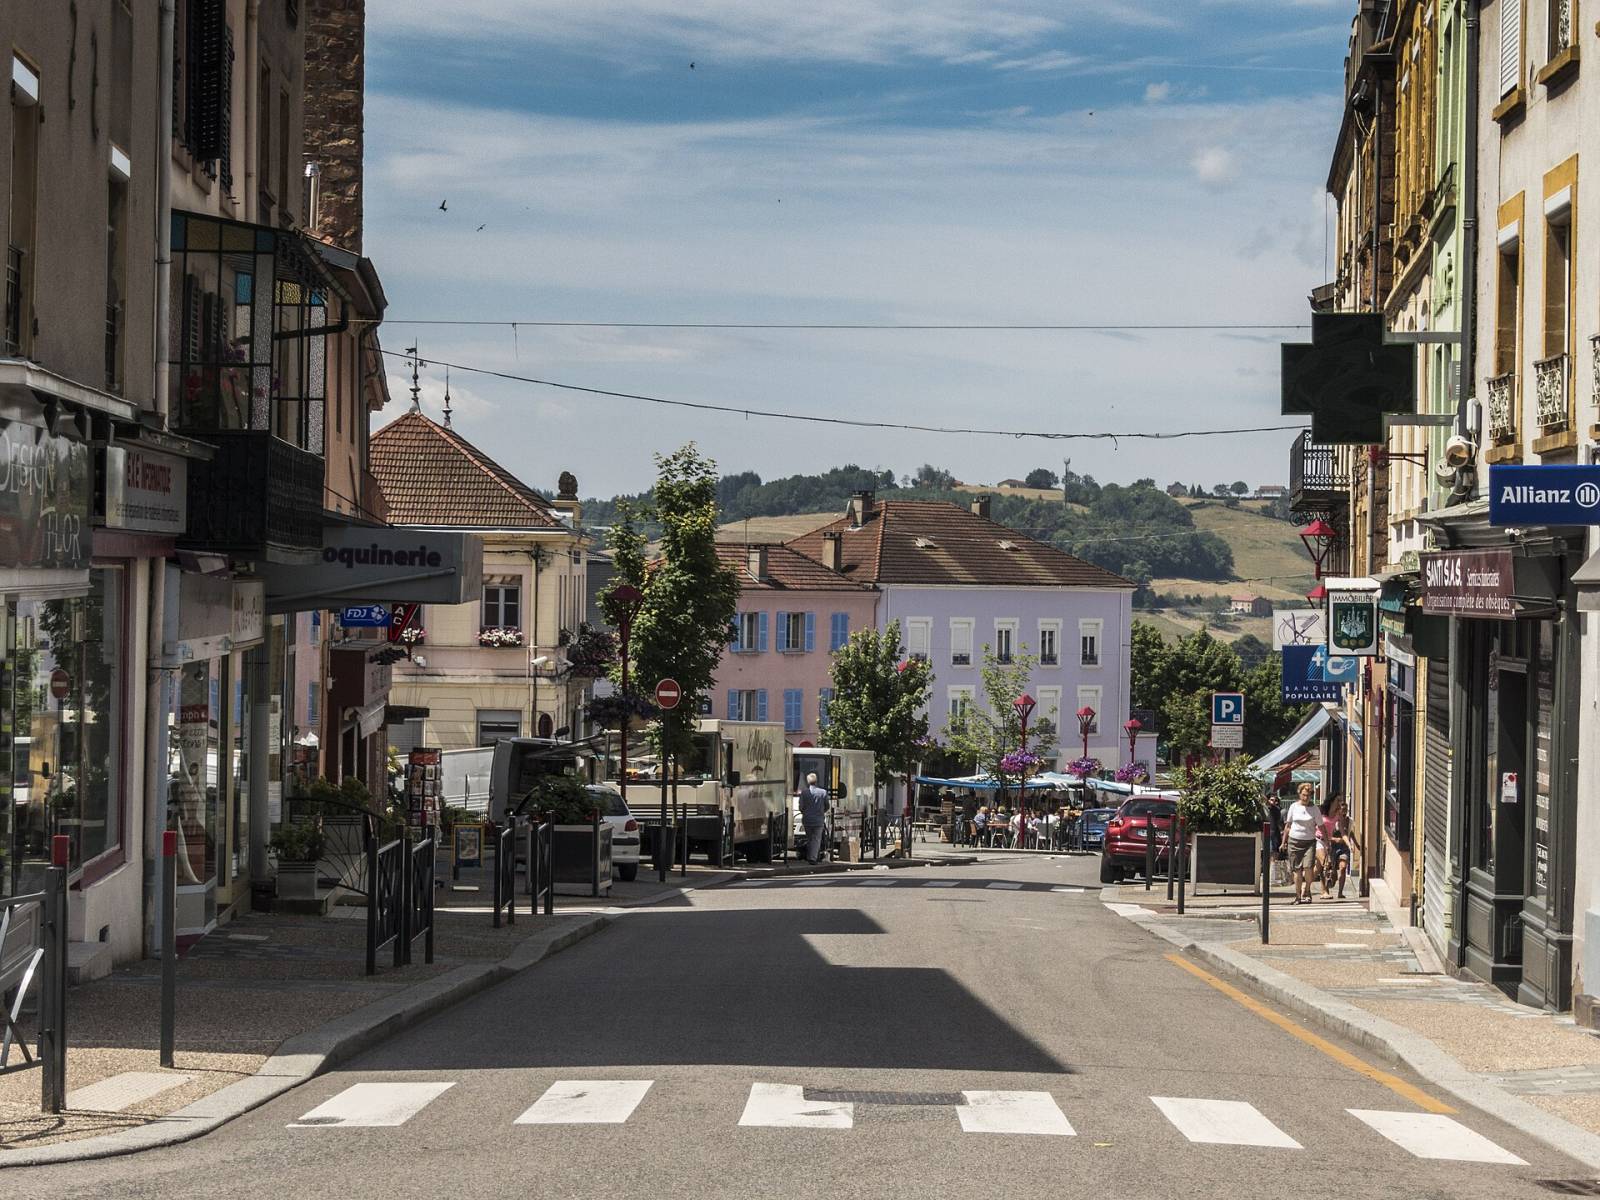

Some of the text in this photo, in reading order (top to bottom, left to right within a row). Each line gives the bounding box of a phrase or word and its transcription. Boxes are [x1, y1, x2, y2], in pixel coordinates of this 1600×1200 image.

[1500, 486, 1571, 504] Allianz
[322, 543, 442, 569] oquinerie
[1426, 559, 1443, 587] SANTI
[1333, 594, 1374, 602] IMMOBILIER
[1475, 592, 1484, 609] des
[346, 608, 367, 618] FDJ
[1221, 699, 1235, 718] P
